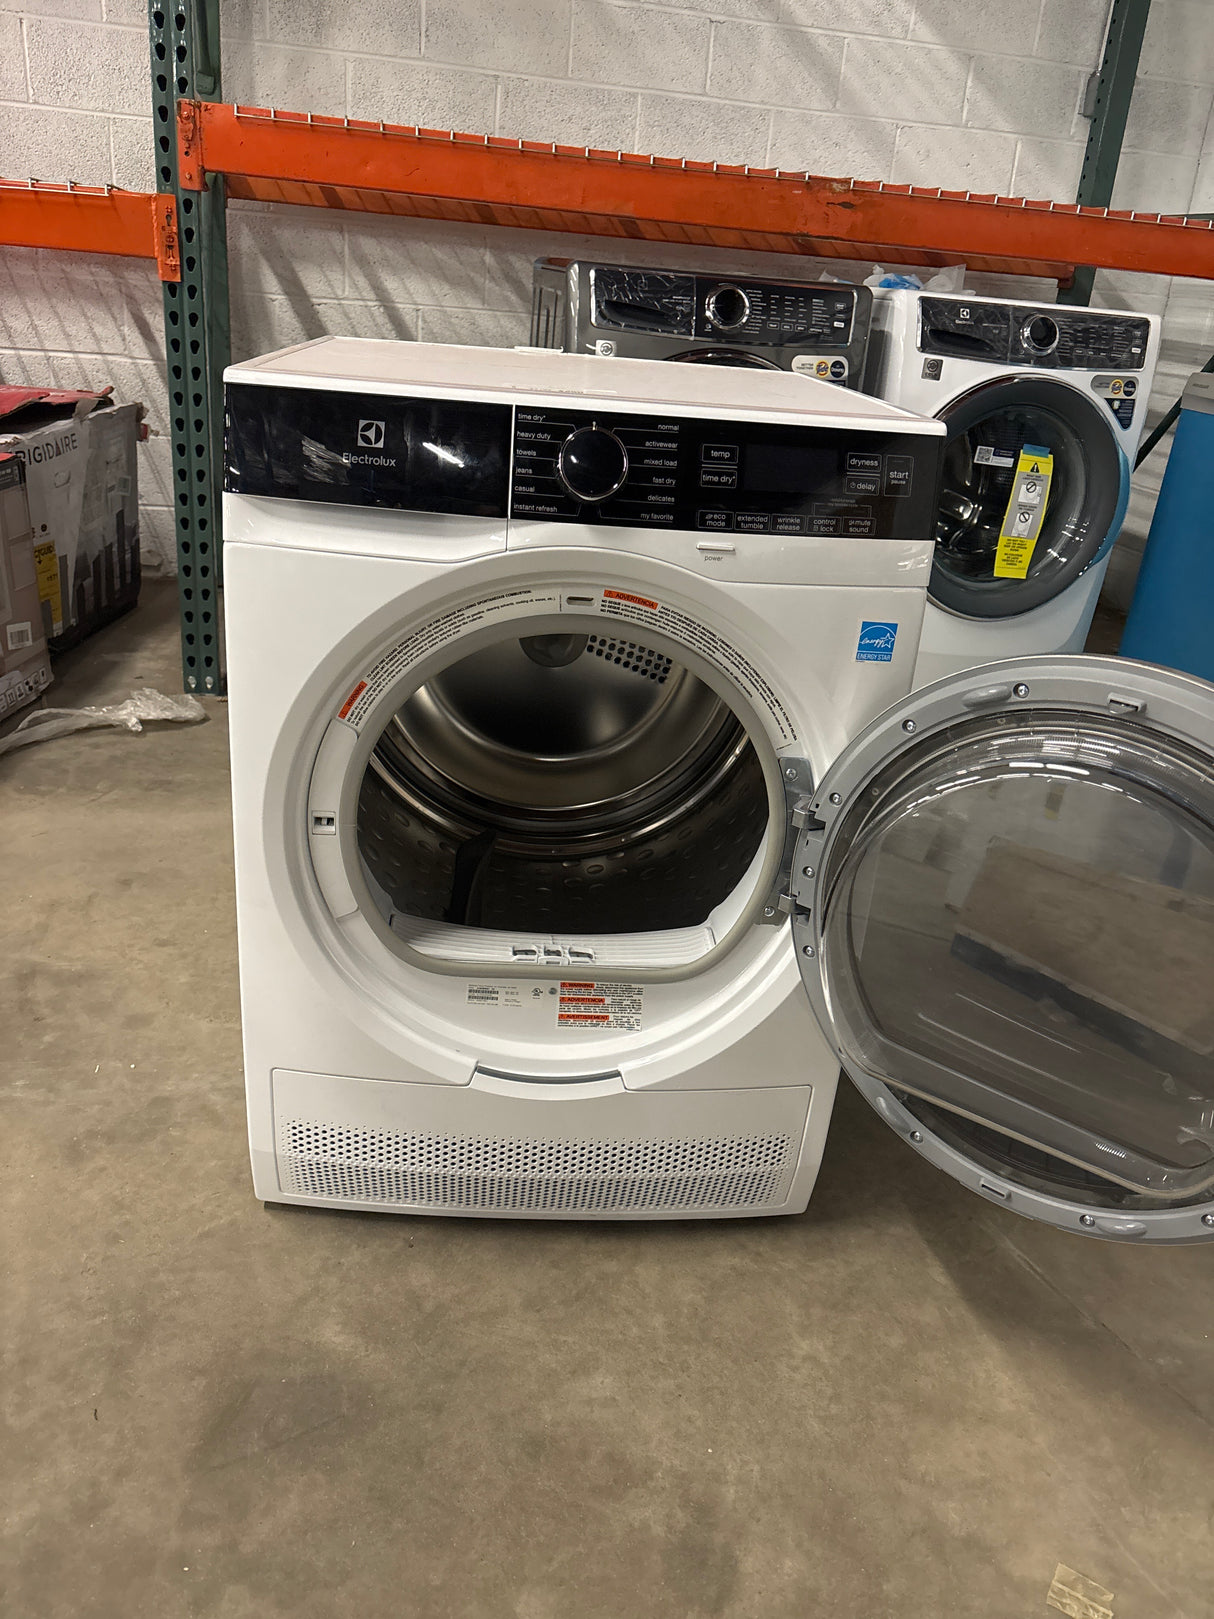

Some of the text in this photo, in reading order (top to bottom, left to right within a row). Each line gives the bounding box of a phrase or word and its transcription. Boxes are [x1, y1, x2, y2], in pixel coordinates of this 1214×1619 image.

[517, 431, 535, 439] heavy
[645, 441, 678, 449] activewear
[711, 450, 730, 459] temp
[342, 453, 396, 466] Electrolux
[850, 458, 878, 467] dryness
[703, 474, 718, 482] time
[889, 471, 909, 479] start
[857, 483, 876, 491] delay
[514, 503, 558, 512] instant refresh
[615, 593, 654, 607] ADVERTENCIA
[346, 684, 363, 706] WARNING
